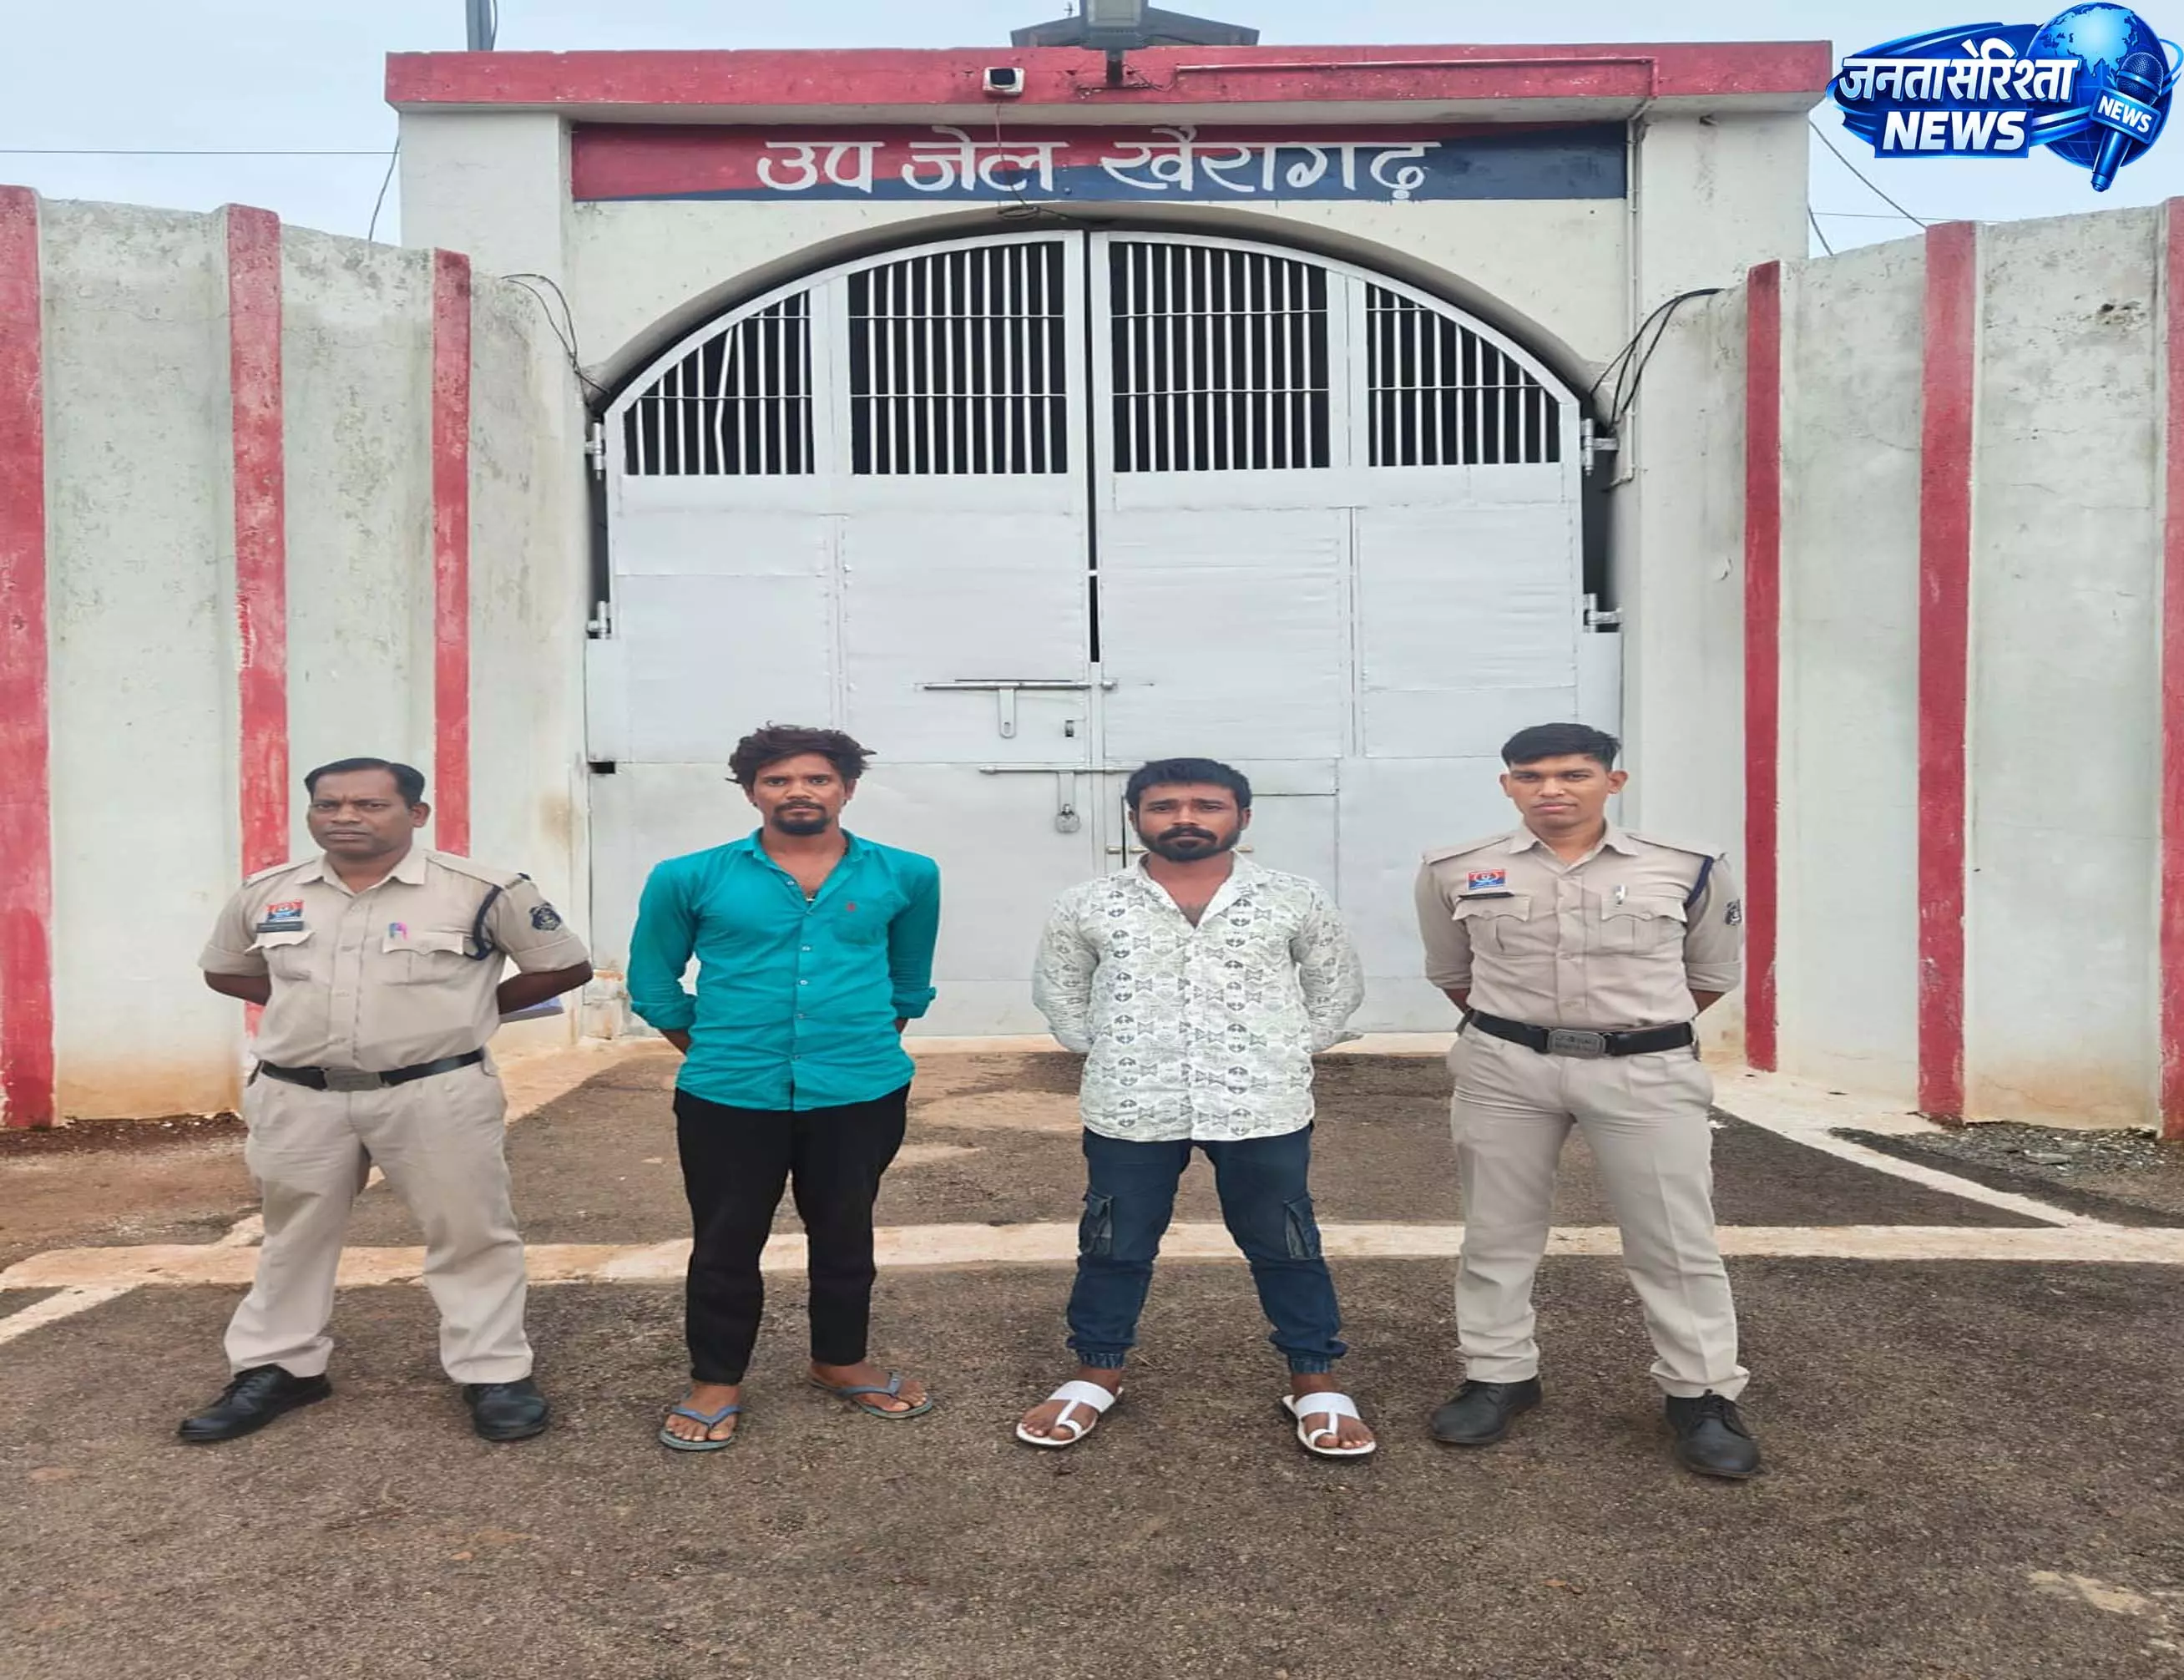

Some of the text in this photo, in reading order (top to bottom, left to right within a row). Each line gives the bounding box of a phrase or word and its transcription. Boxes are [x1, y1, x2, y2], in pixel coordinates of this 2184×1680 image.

[757, 125, 1442, 200] उप जेल खैरागढ़
